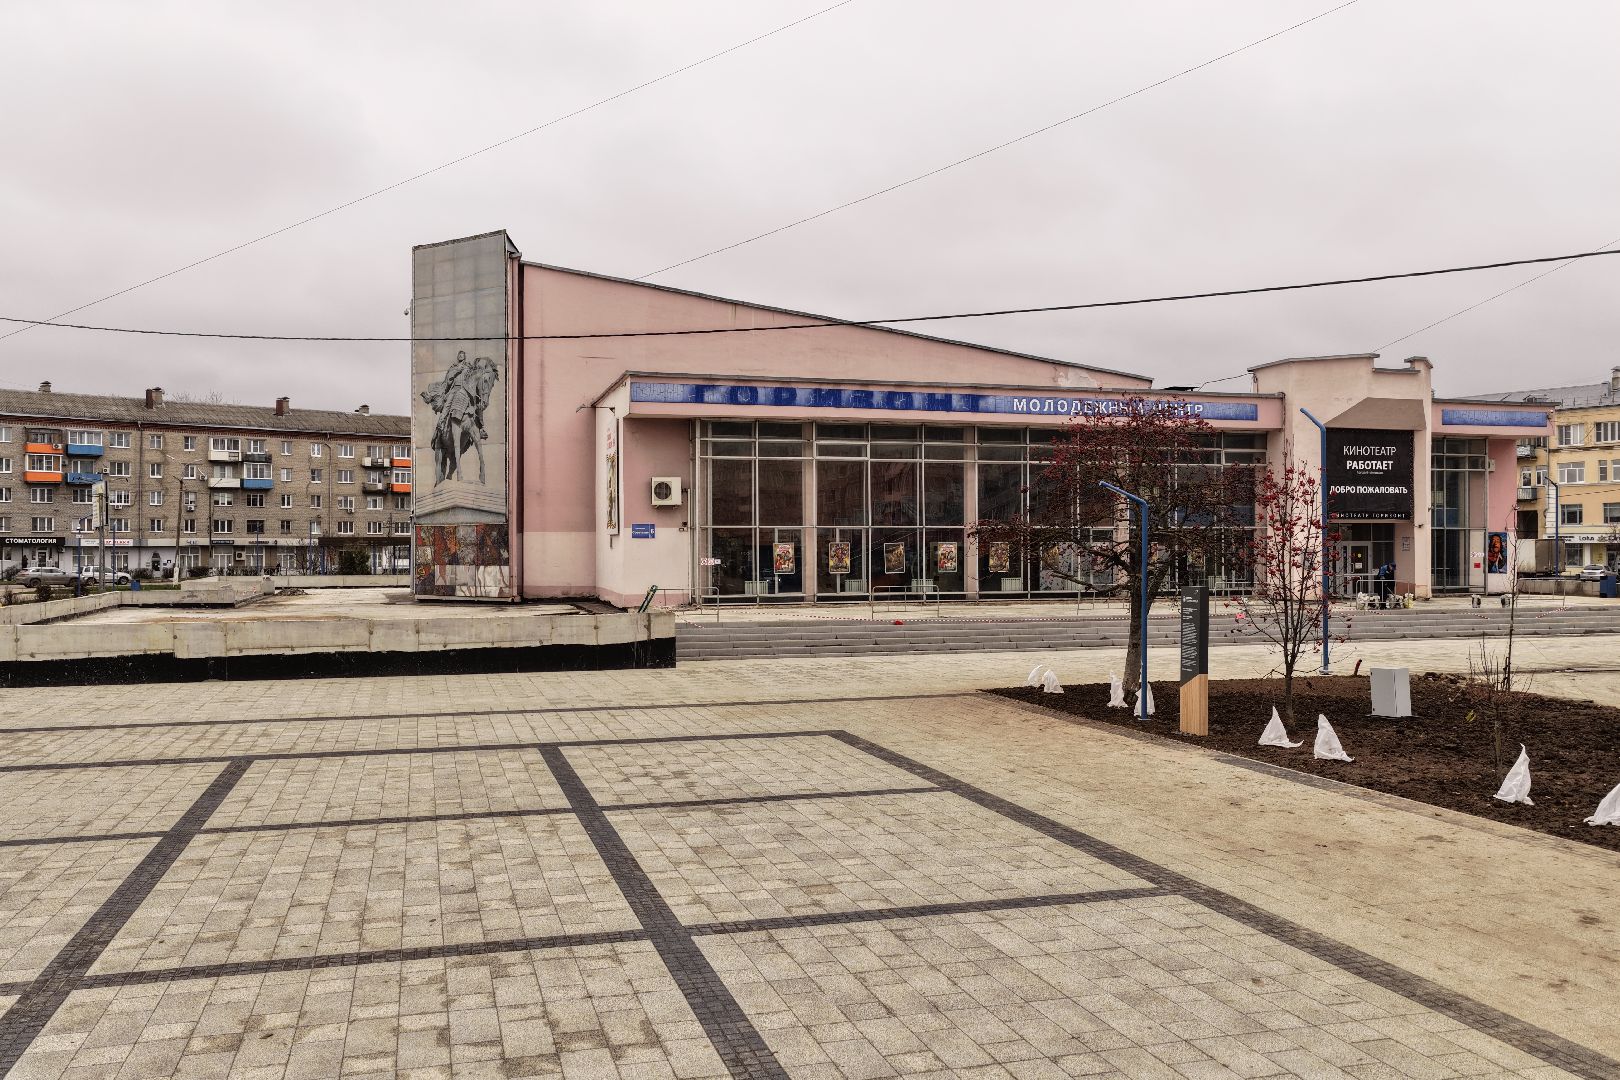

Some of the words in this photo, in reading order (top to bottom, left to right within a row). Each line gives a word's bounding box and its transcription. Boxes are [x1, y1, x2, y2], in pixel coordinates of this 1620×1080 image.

[1343, 445, 1397, 456] КИНОТЕАТР
[1346, 460, 1394, 470] РАБОТАЕТ
[1329, 485, 1356, 495] ДОБРО
[1356, 485, 1408, 494] ПОЖАЛОВАТЬ
